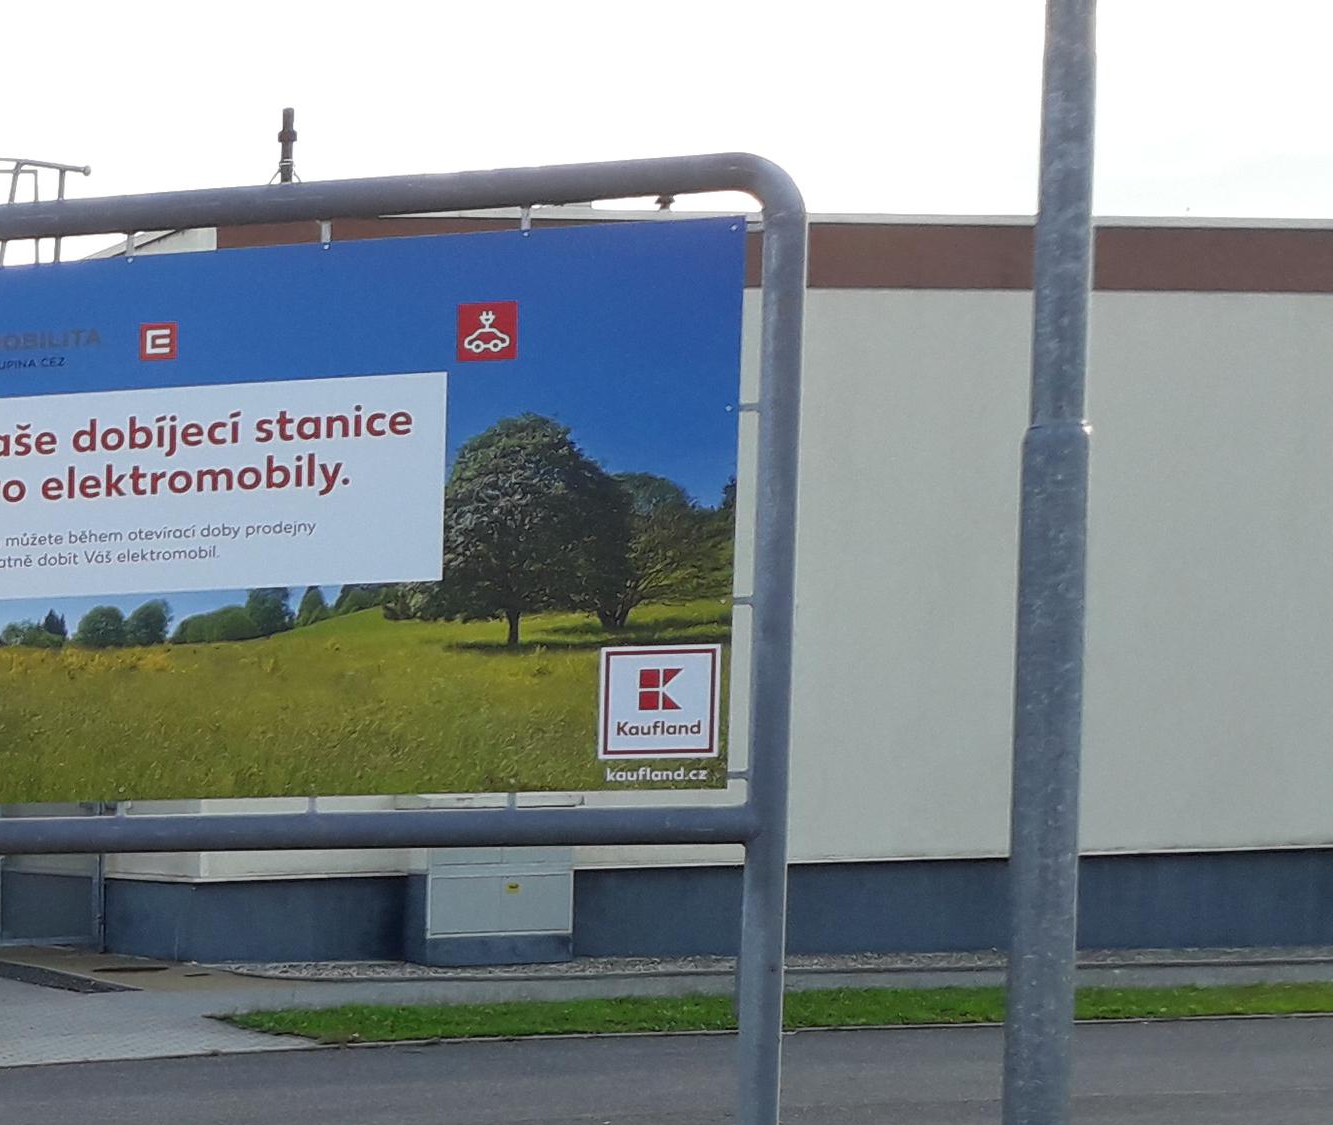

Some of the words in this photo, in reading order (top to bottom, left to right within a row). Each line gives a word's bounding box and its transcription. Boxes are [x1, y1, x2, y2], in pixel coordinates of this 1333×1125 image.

[72, 411, 242, 457] dobíjecí
[255, 404, 413, 443] stanice
[41, 453, 350, 501] elektromobily.
[6, 532, 64, 547] můžete
[69, 530, 123, 545] během
[128, 526, 195, 541] otevírací
[200, 523, 240, 540] doby
[245, 521, 317, 538] prodejny
[37, 552, 79, 567] dobít
[84, 550, 112, 564] Váš
[117, 545, 220, 563] elektromobil.
[616, 720, 702, 736] Kaufland
[606, 767, 708, 781] kaufland.cz
